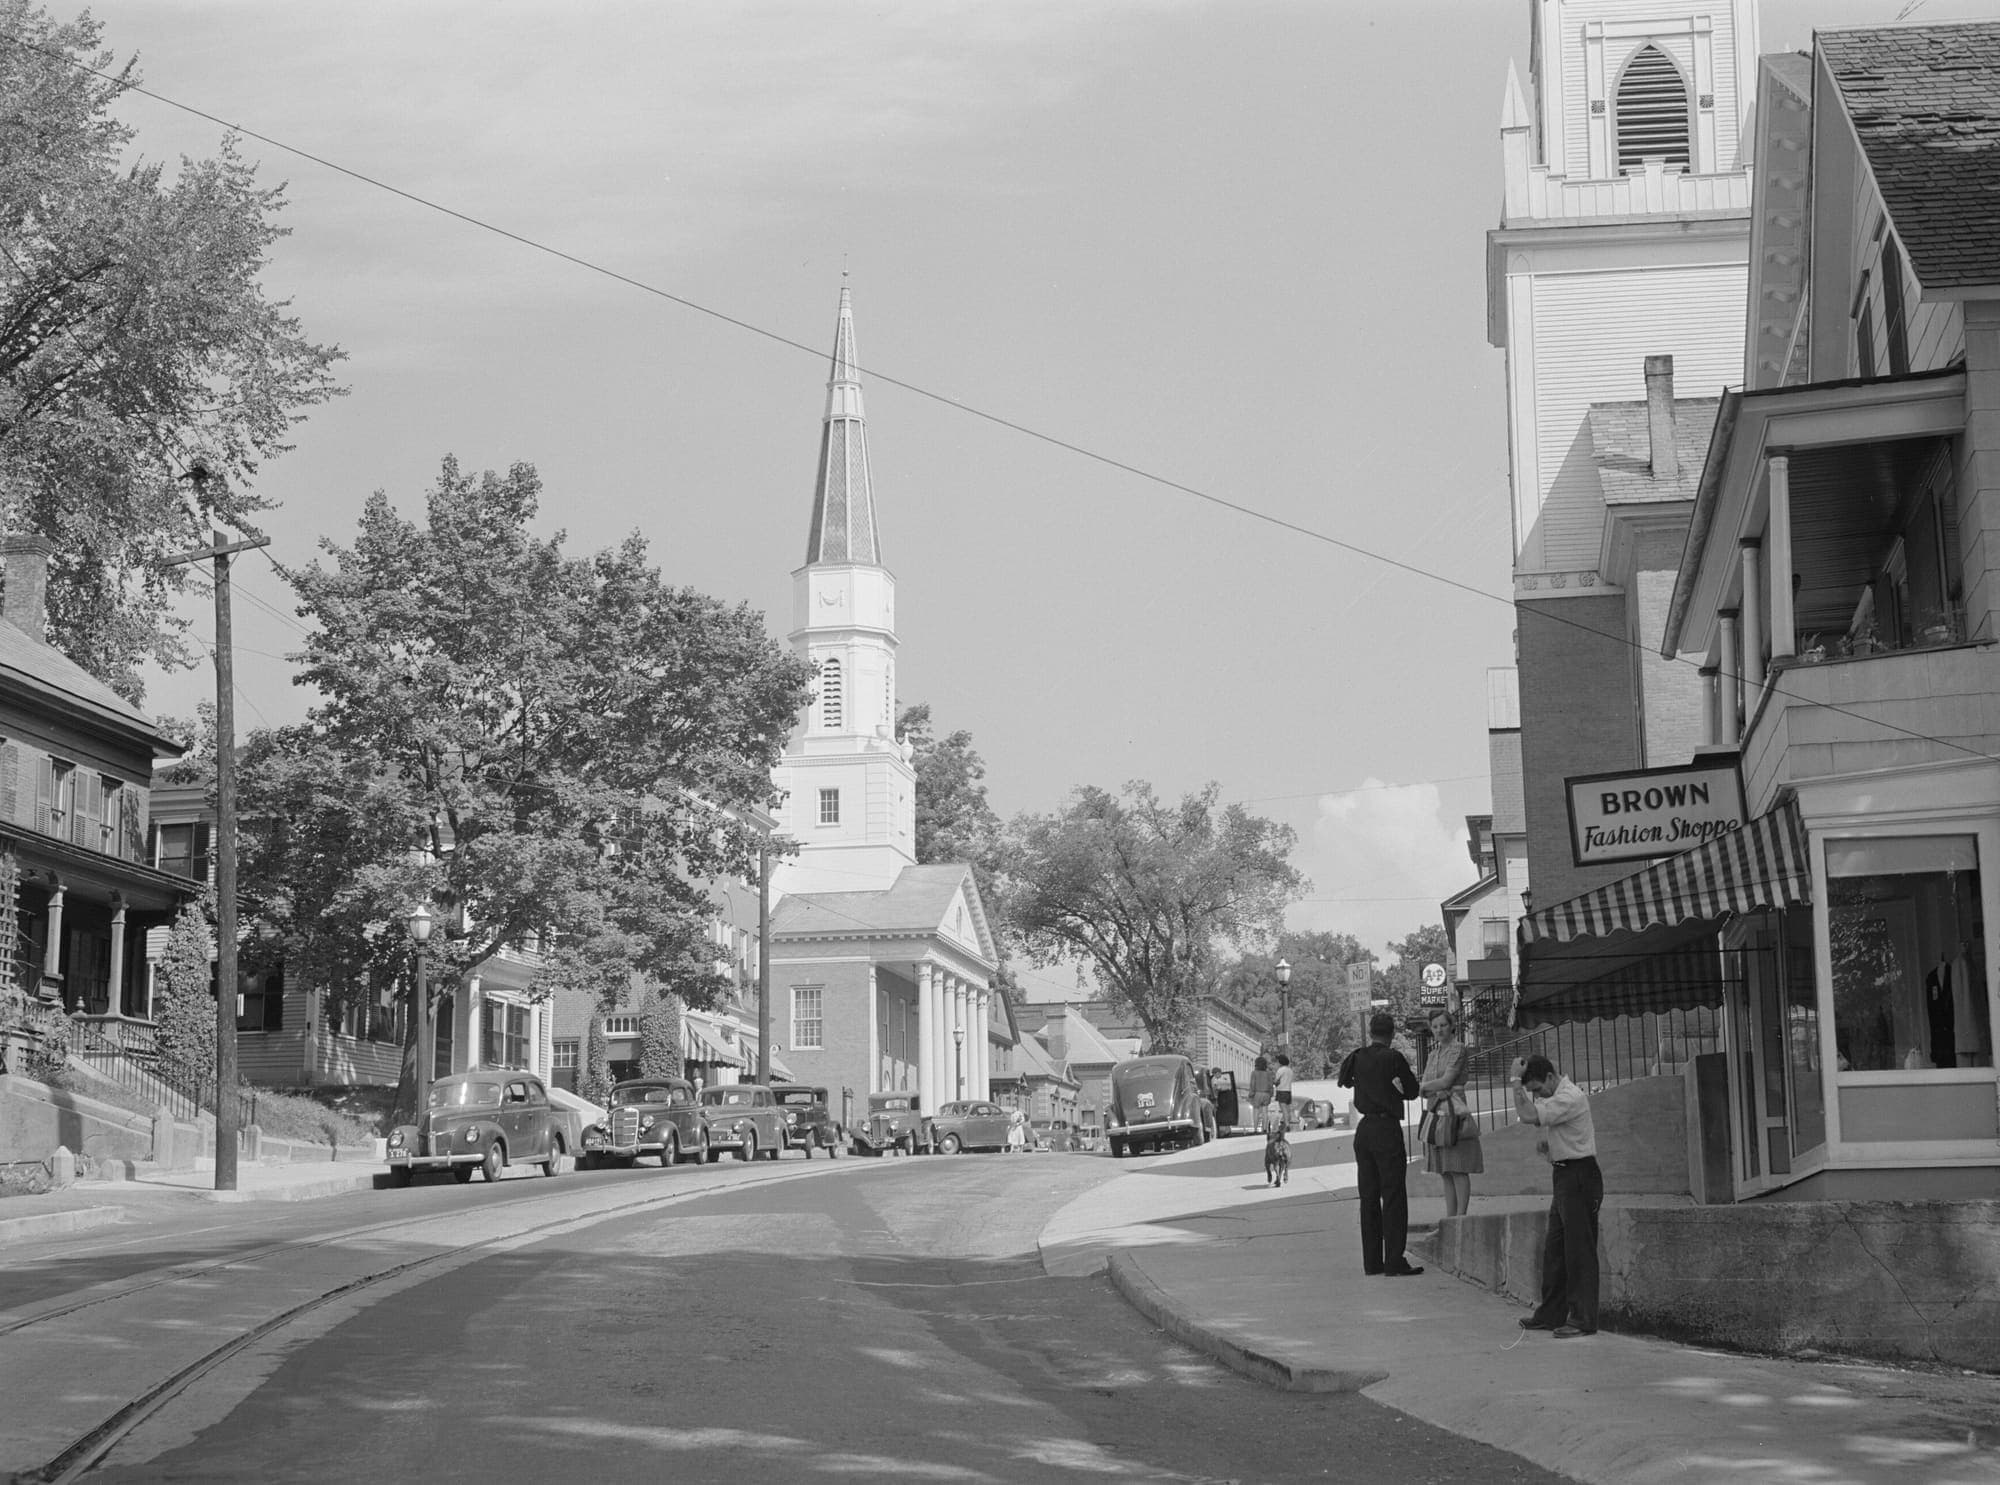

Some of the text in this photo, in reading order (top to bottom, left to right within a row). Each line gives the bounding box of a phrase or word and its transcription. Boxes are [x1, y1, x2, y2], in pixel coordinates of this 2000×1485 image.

[1601, 782, 1709, 815] BROWN
[1585, 816, 1738, 852] Fashion Shoppe
[1420, 986, 1448, 995] SUPER
